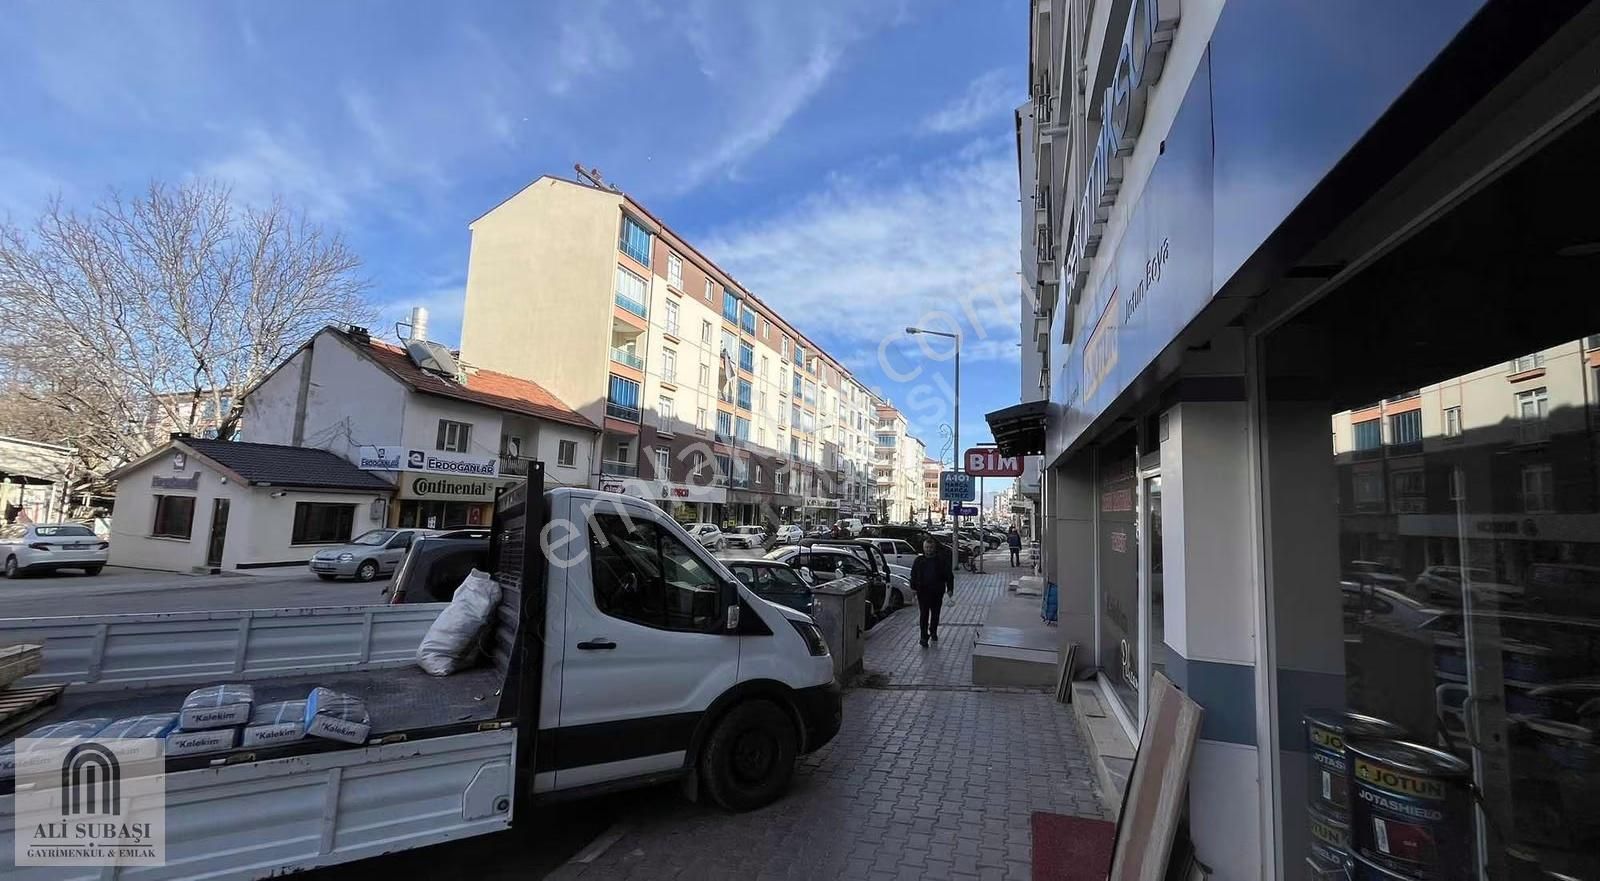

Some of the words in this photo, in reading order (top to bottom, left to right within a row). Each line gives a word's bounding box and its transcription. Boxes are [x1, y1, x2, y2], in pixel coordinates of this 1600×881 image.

[1124, 279, 1146, 325] Jotun
[412, 477, 487, 496] Continental
[1374, 769, 1441, 796] JOTUN
[1359, 789, 1442, 820] JOTASHIELD
